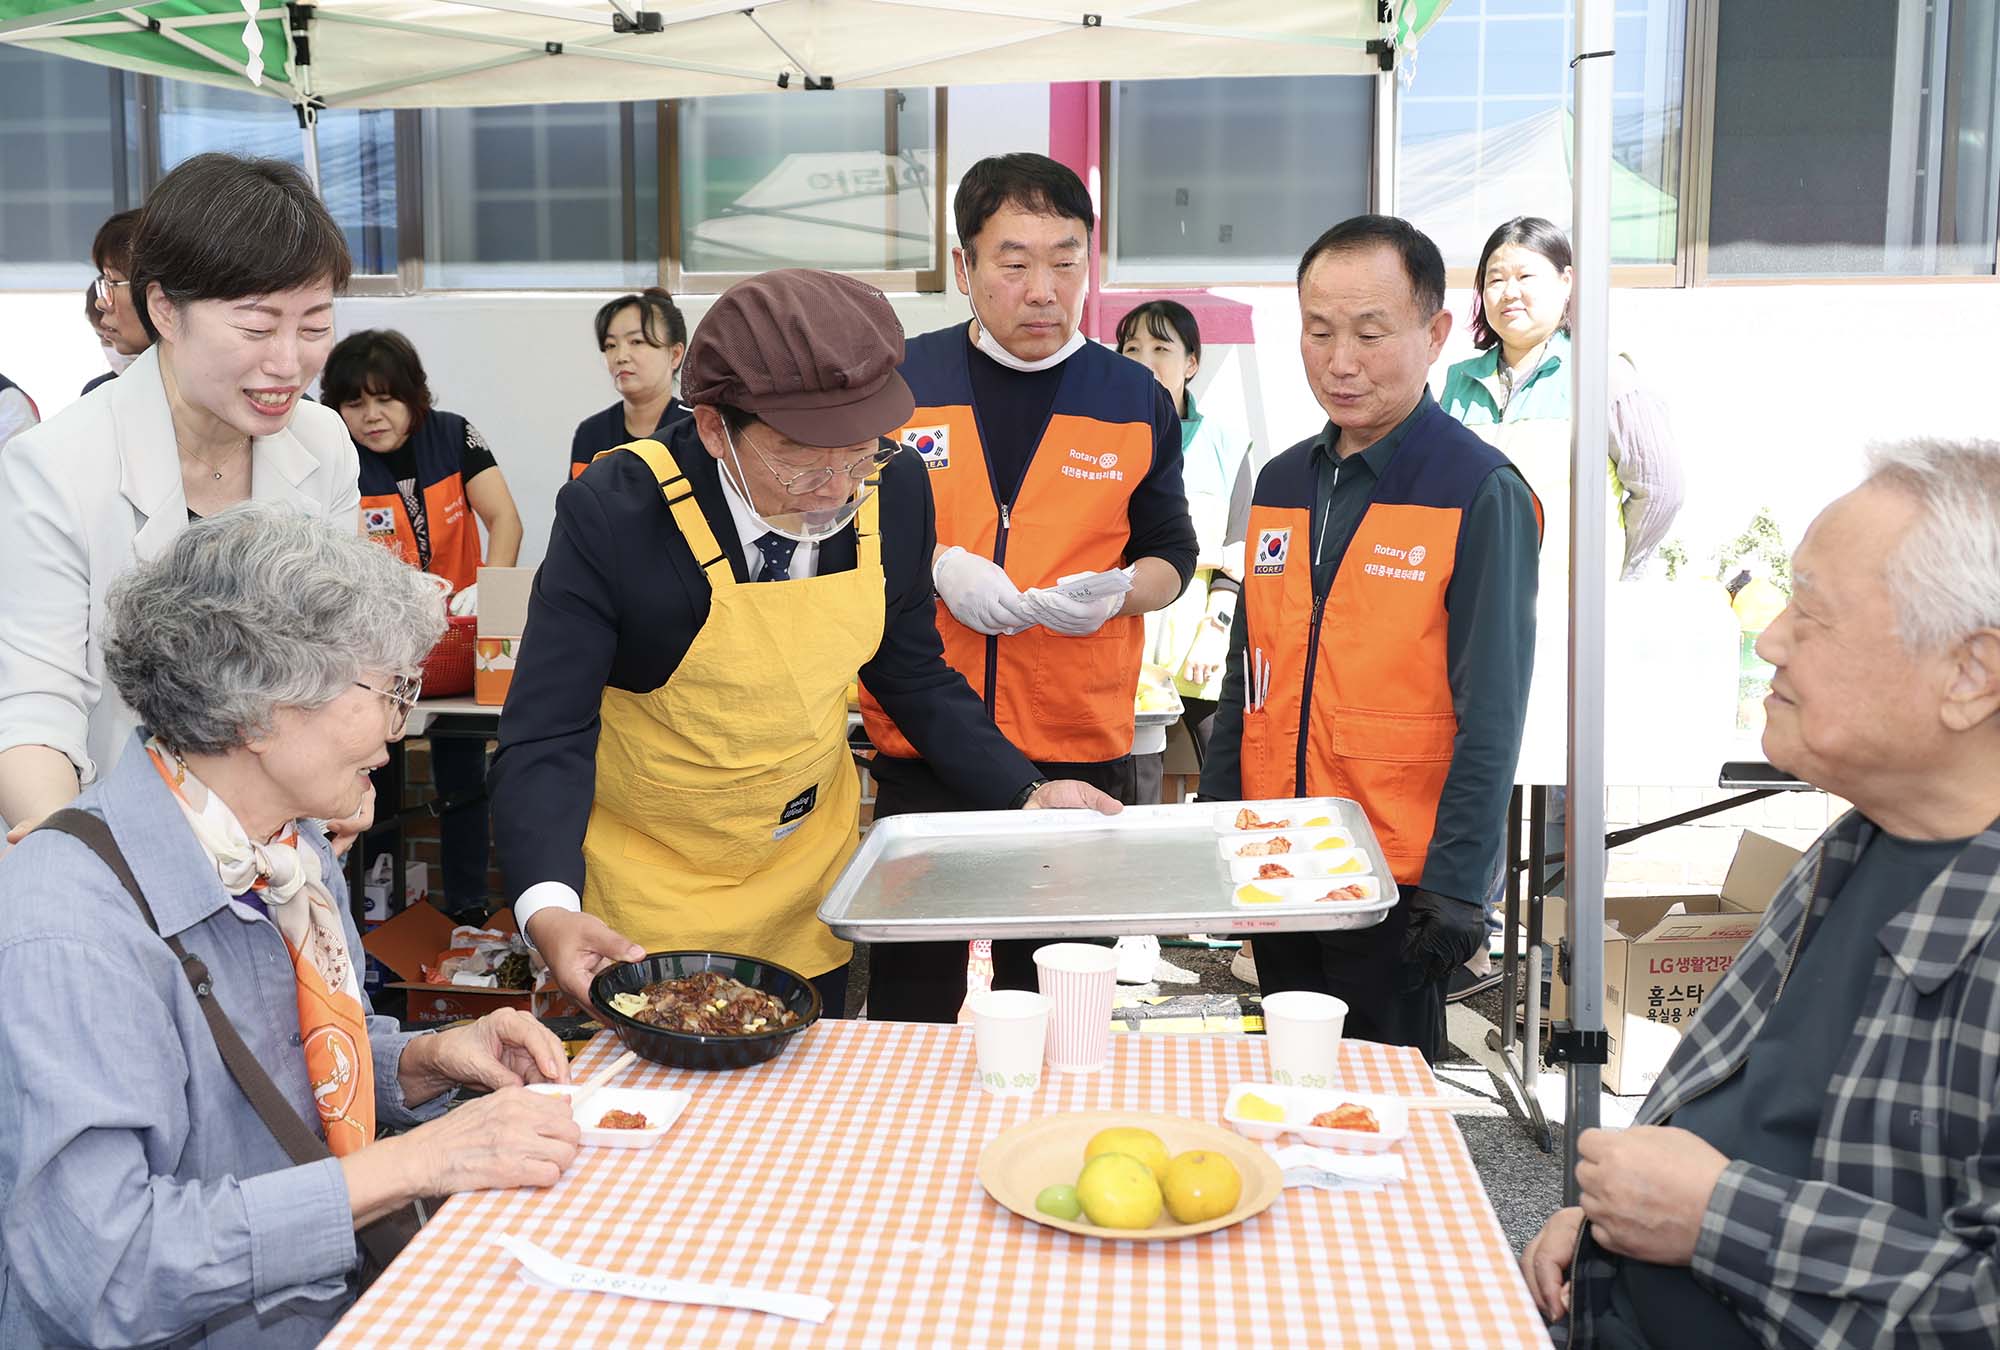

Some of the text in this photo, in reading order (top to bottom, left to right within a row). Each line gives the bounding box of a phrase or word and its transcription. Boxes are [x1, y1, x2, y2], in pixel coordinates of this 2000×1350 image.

[1069, 448, 1098, 465] Rotary
[1374, 544, 1407, 560] Rotary
[1256, 565, 1284, 574] KOREA
[1647, 983, 1705, 1007] 홈스타
[1646, 1007, 1682, 1024] 욕실용
